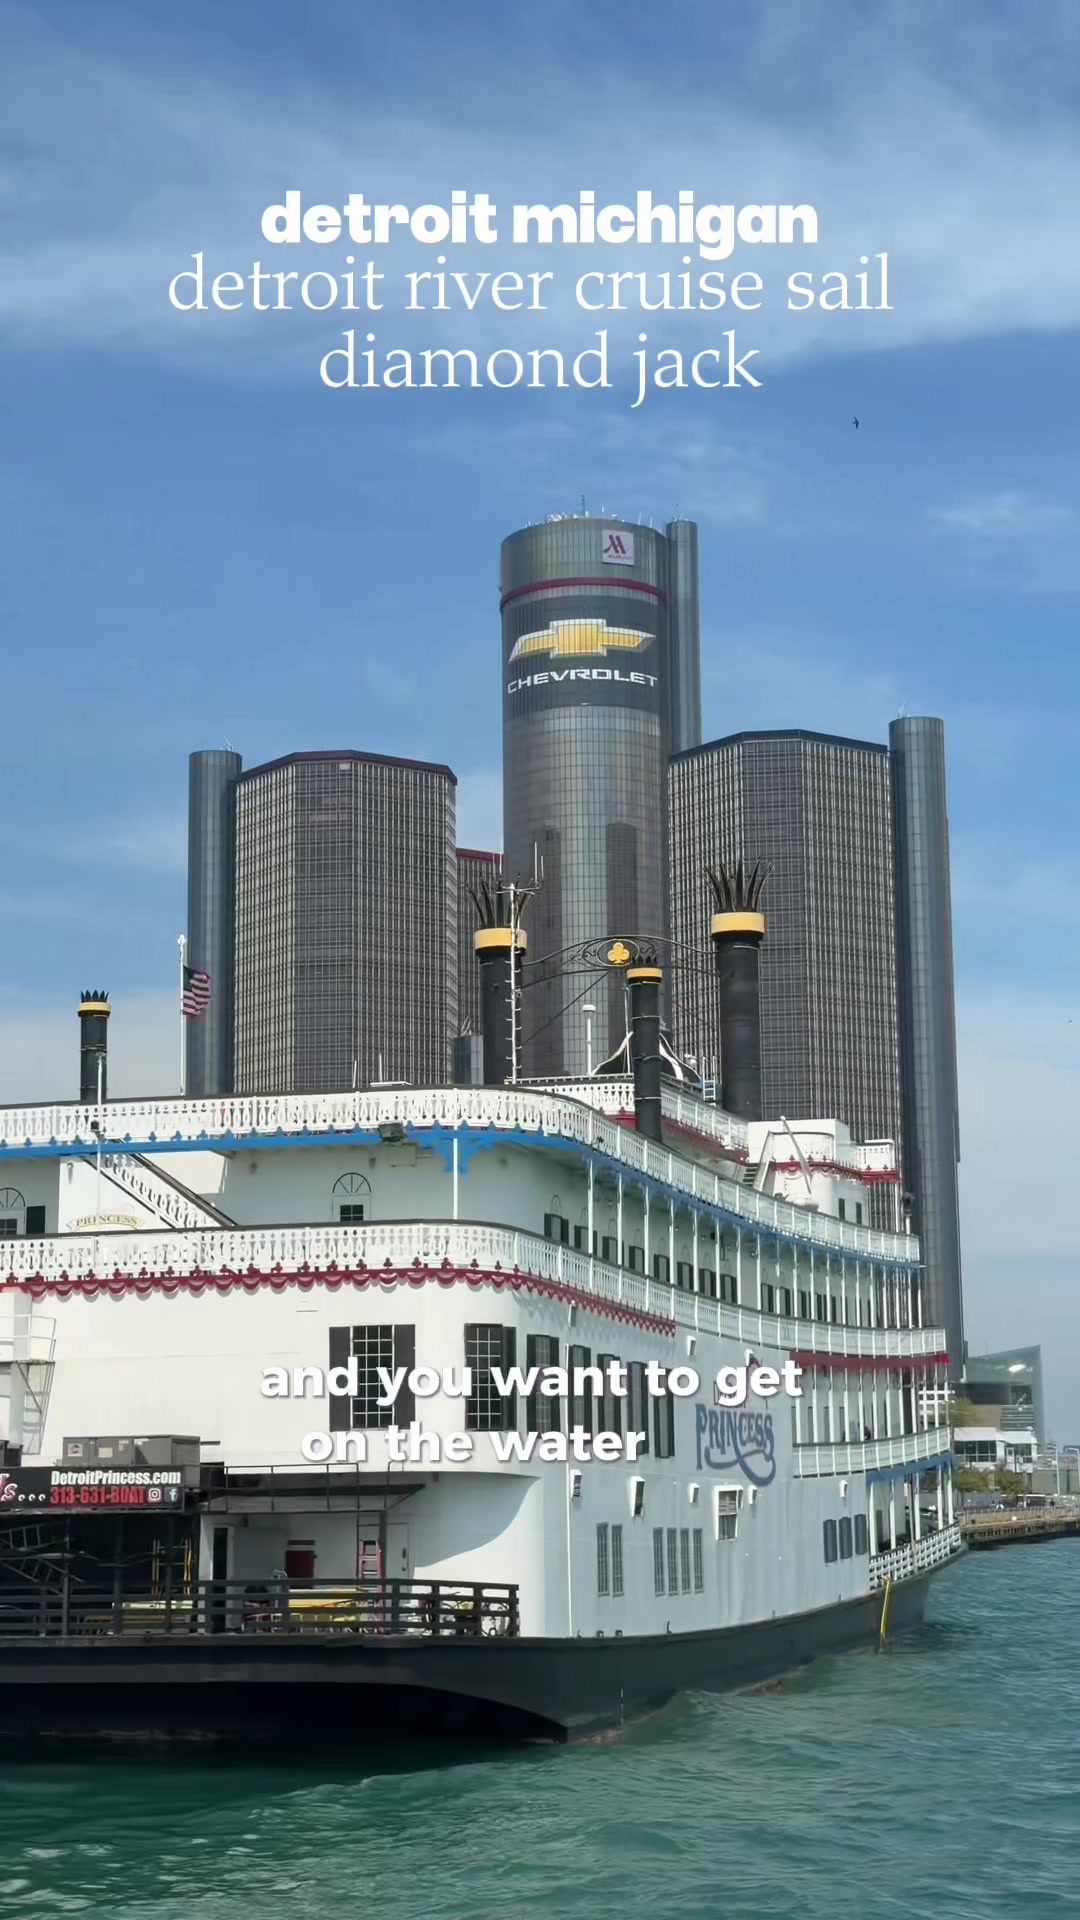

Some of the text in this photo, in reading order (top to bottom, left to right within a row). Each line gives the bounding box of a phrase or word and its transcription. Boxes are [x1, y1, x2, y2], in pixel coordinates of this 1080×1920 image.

[507, 668, 658, 694] CHEVROLET
[75, 1216, 139, 1228] PRINCESS
[695, 1403, 776, 1486] PRINCESS
[50, 1470, 182, 1486] DetroitPrincess.com
[49, 1486, 147, 1505] 313-631-BOAT
